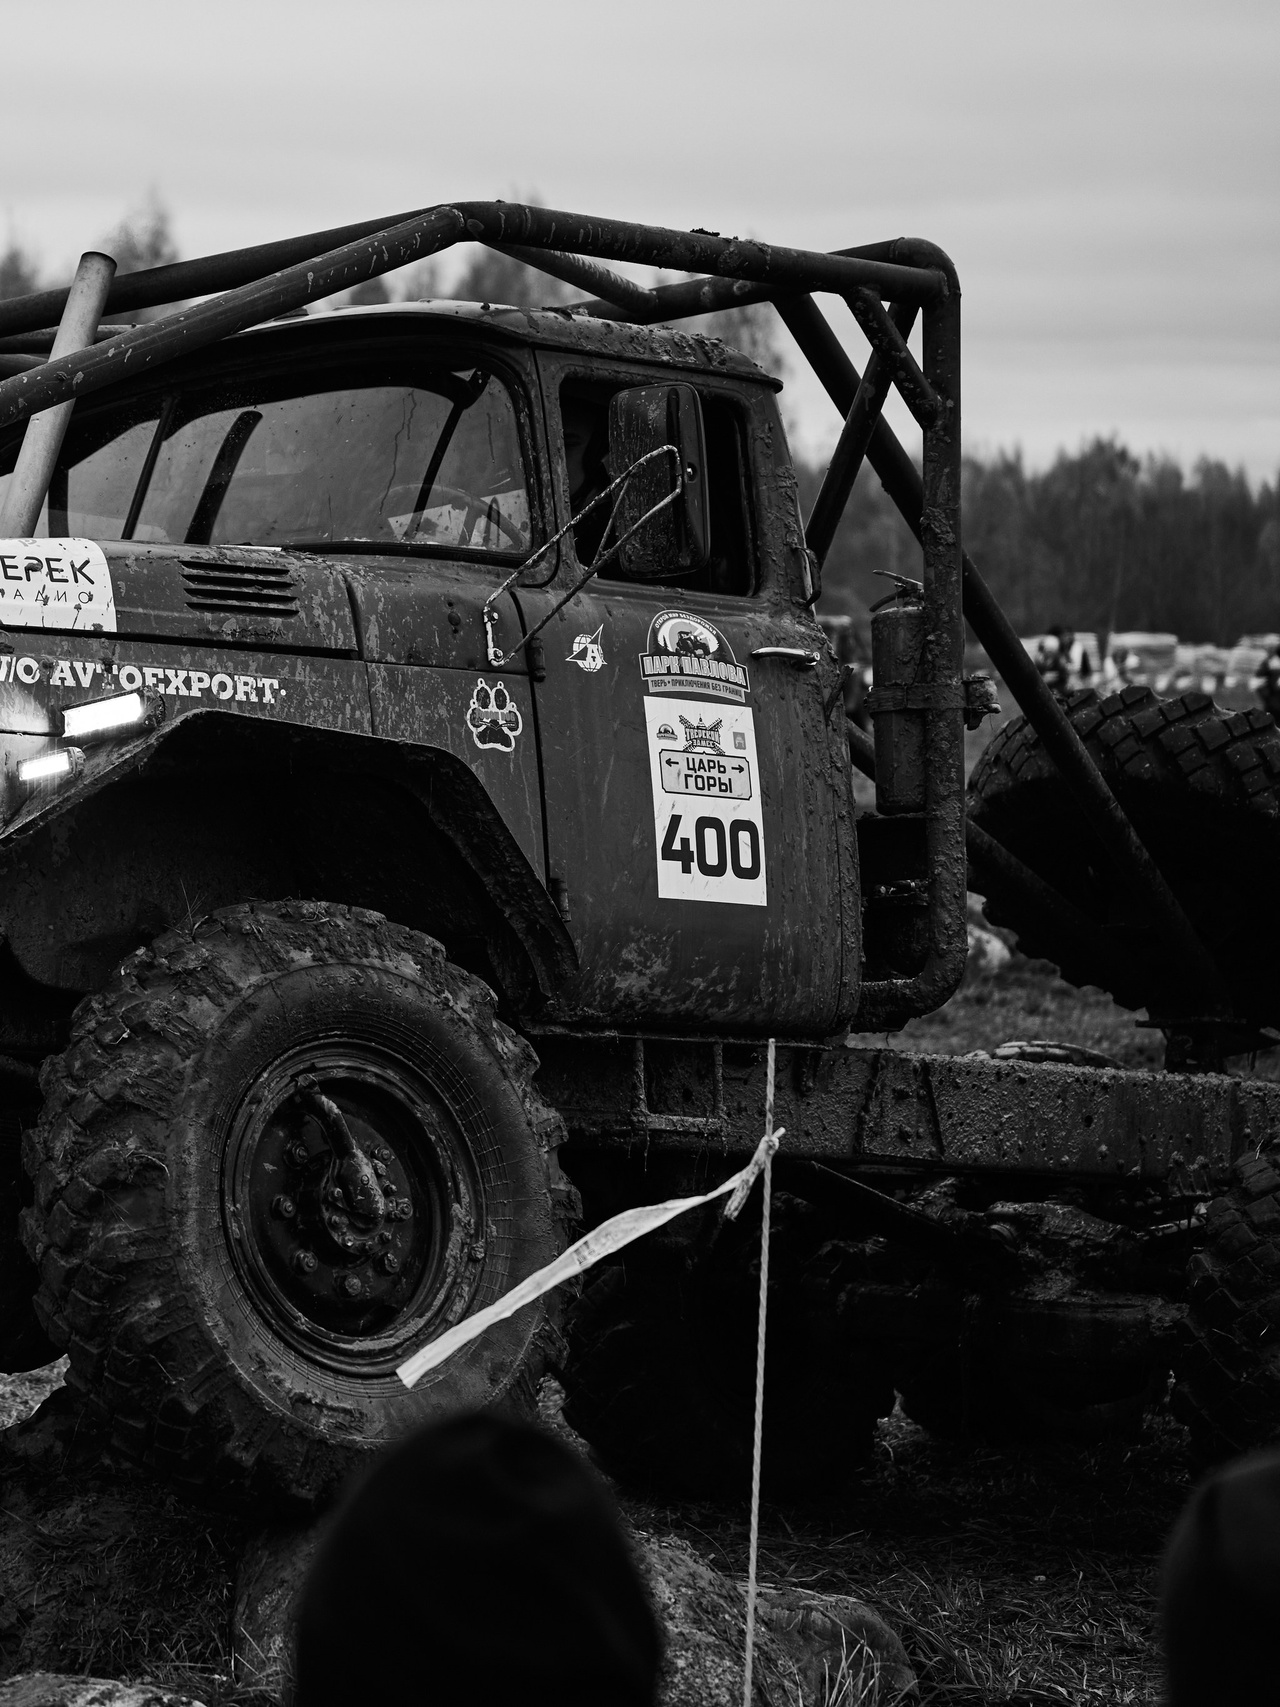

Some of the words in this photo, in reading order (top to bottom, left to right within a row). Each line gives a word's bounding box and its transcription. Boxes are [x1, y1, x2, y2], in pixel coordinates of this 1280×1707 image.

[643, 656, 680, 675] ПАРК
[681, 656, 747, 686] ПАВЛОВА
[650, 680, 667, 688] ТВЕРЬ
[670, 679, 711, 690] ПРИКЛЮЧЕНИЯ
[711, 682, 722, 692] БЕЗ
[686, 757, 727, 774] ЦАРЬ
[684, 773, 733, 793] ГОРЫ
[661, 813, 761, 880] 400
